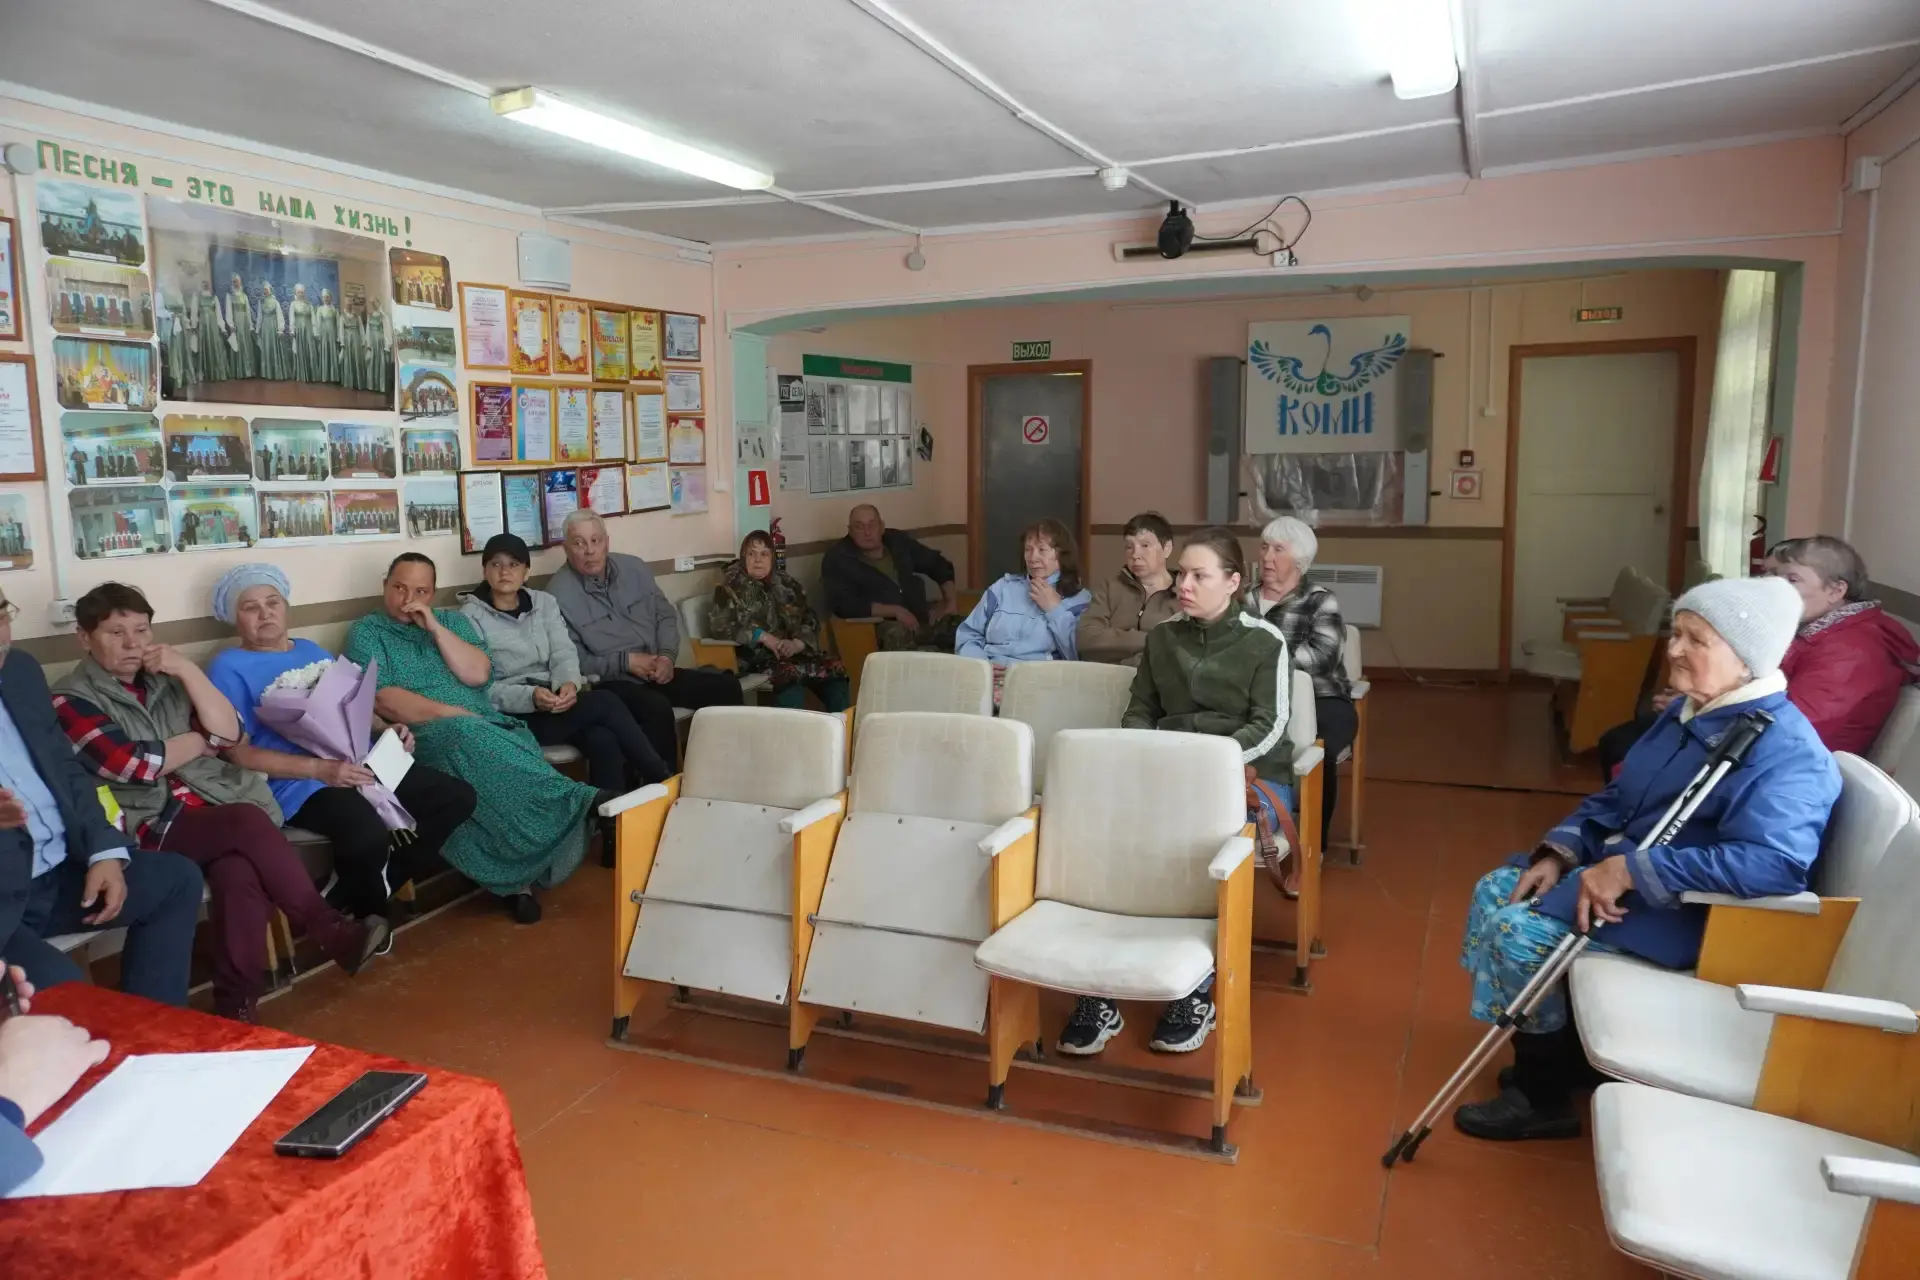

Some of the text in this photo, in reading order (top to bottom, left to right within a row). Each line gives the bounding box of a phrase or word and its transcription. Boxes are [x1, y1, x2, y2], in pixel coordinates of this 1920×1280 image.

[36, 139, 139, 187] ПЕСНЯ
[186, 176, 235, 207] ЭТО
[258, 191, 317, 221] НАША
[1012, 342, 1050, 359] ВЫХОД
[1276, 391, 1375, 436] КОМИ
